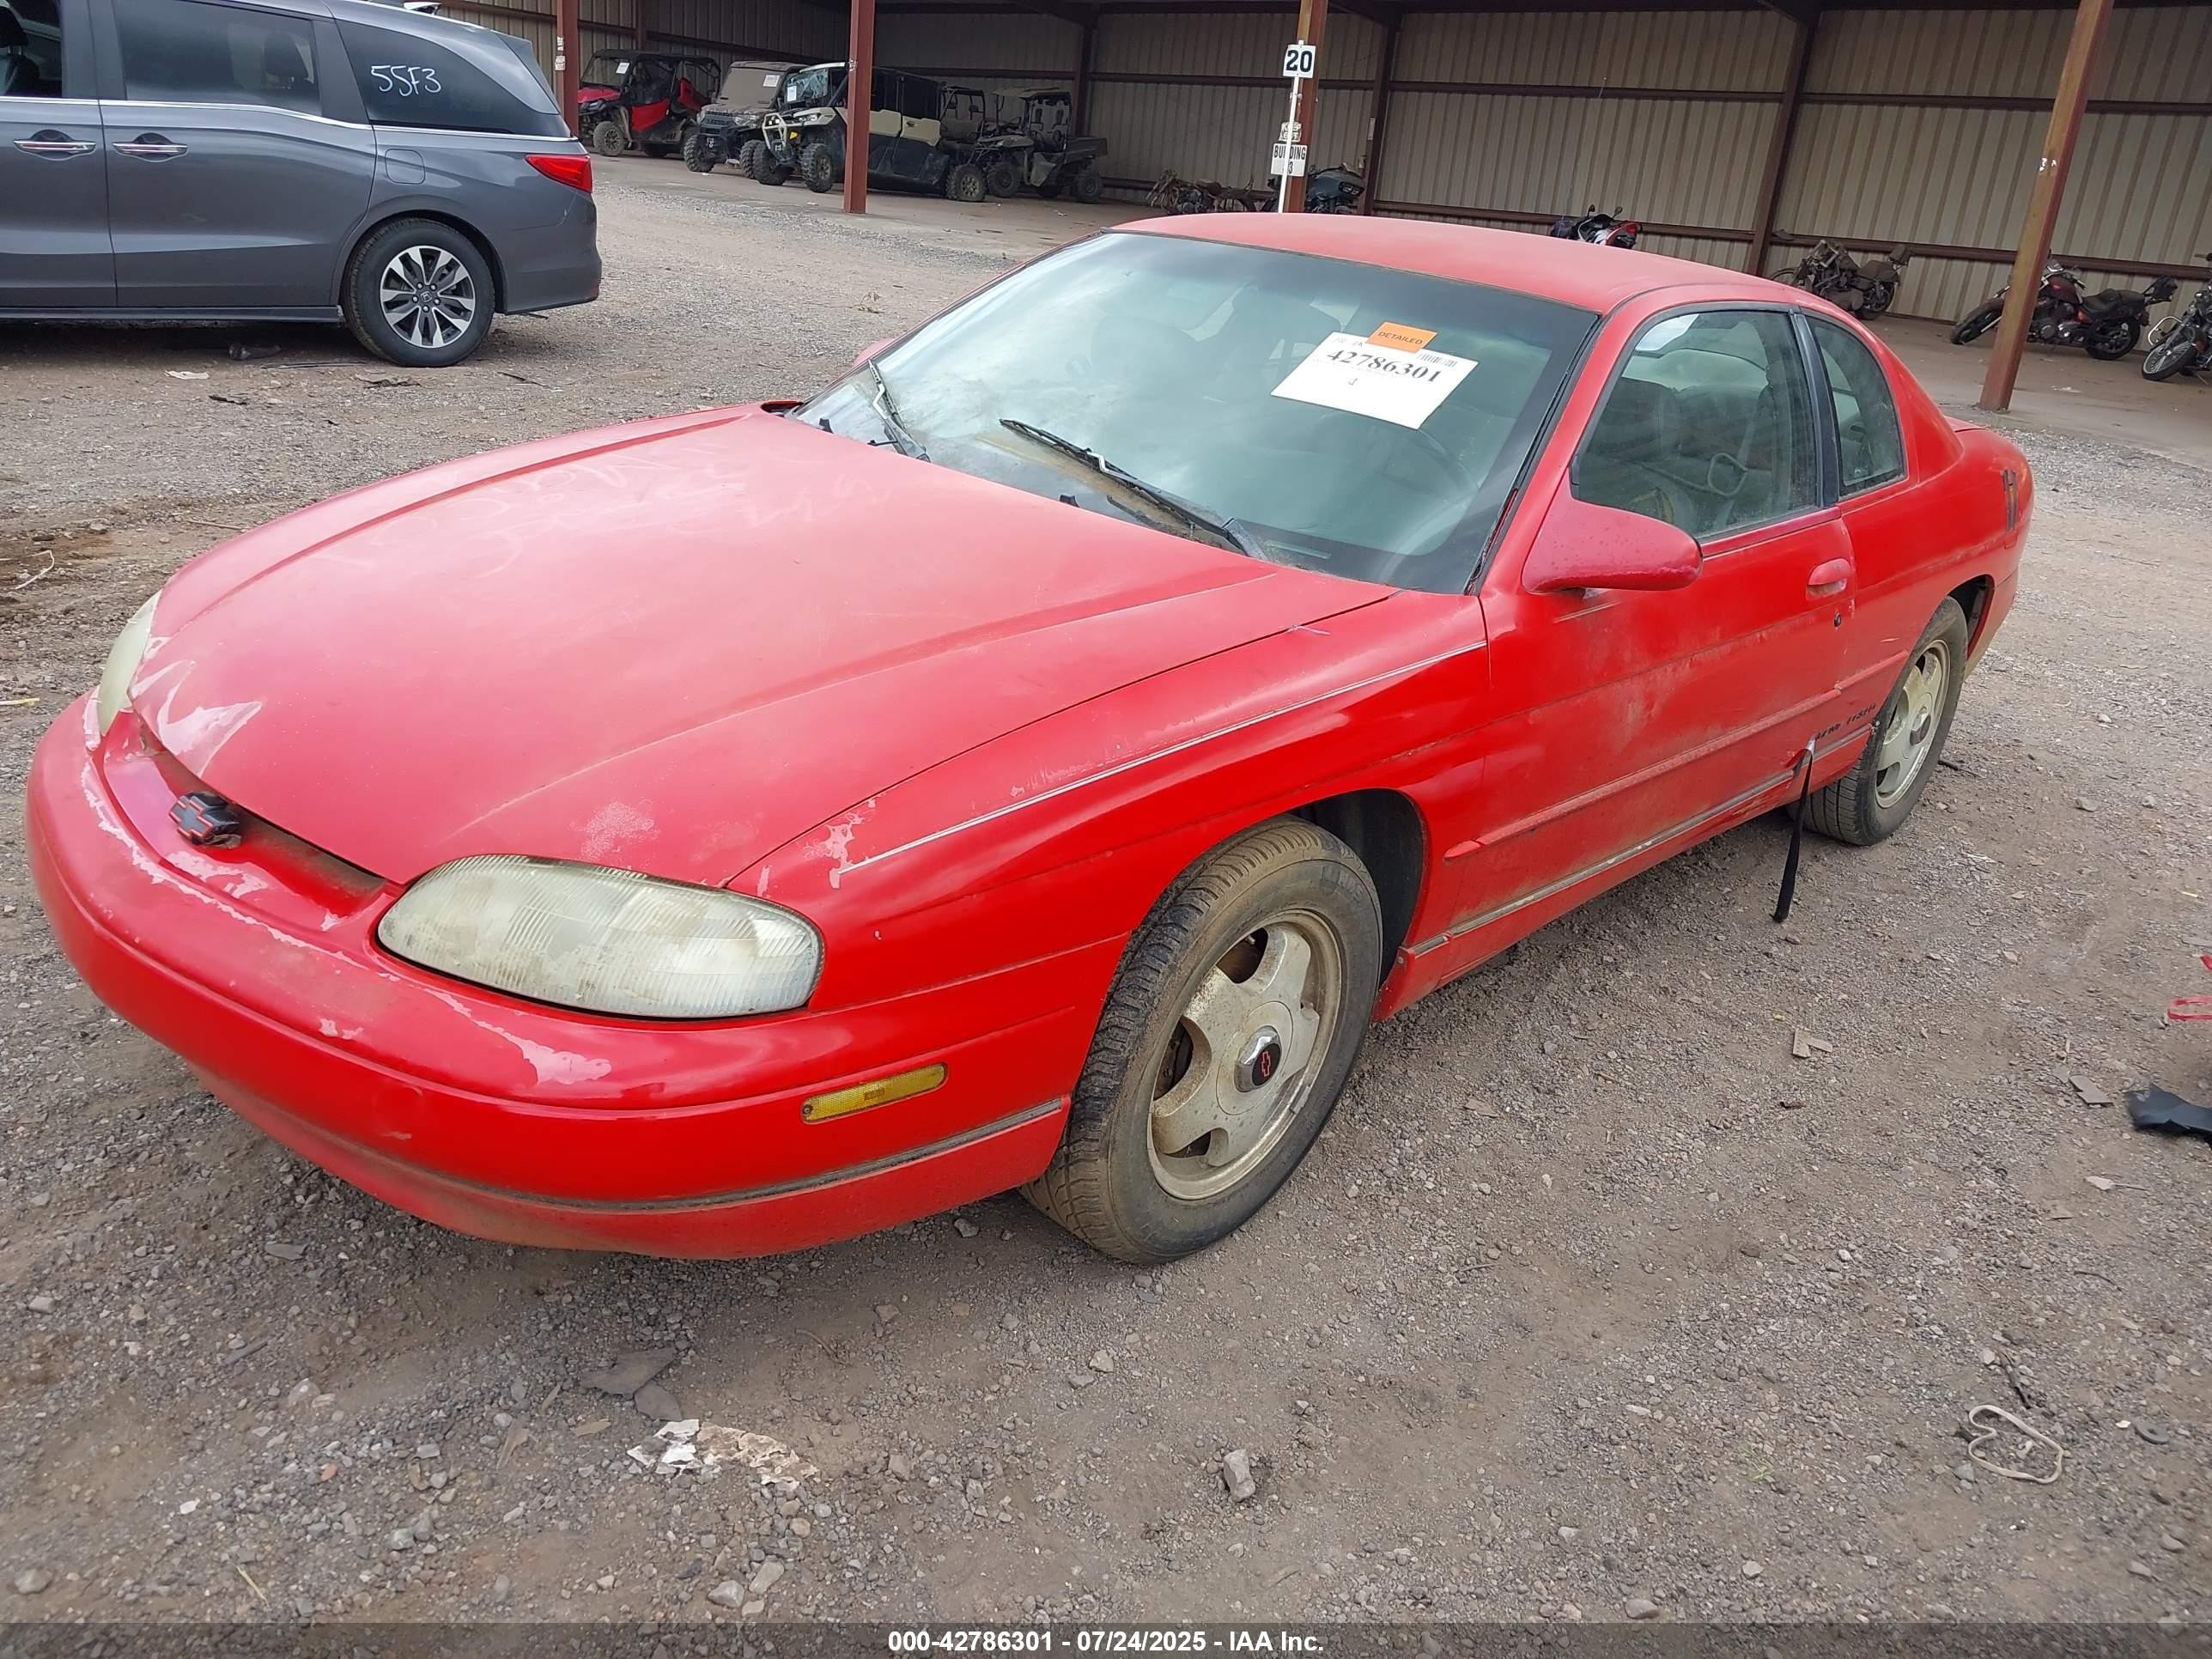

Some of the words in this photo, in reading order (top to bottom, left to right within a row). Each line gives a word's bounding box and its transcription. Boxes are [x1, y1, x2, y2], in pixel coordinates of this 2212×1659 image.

[1285, 49, 1312, 73] 20
[1273, 145, 1306, 161] BUIDING
[1377, 331, 1423, 345] DETAILED
[1326, 349, 1442, 383] 42786301
